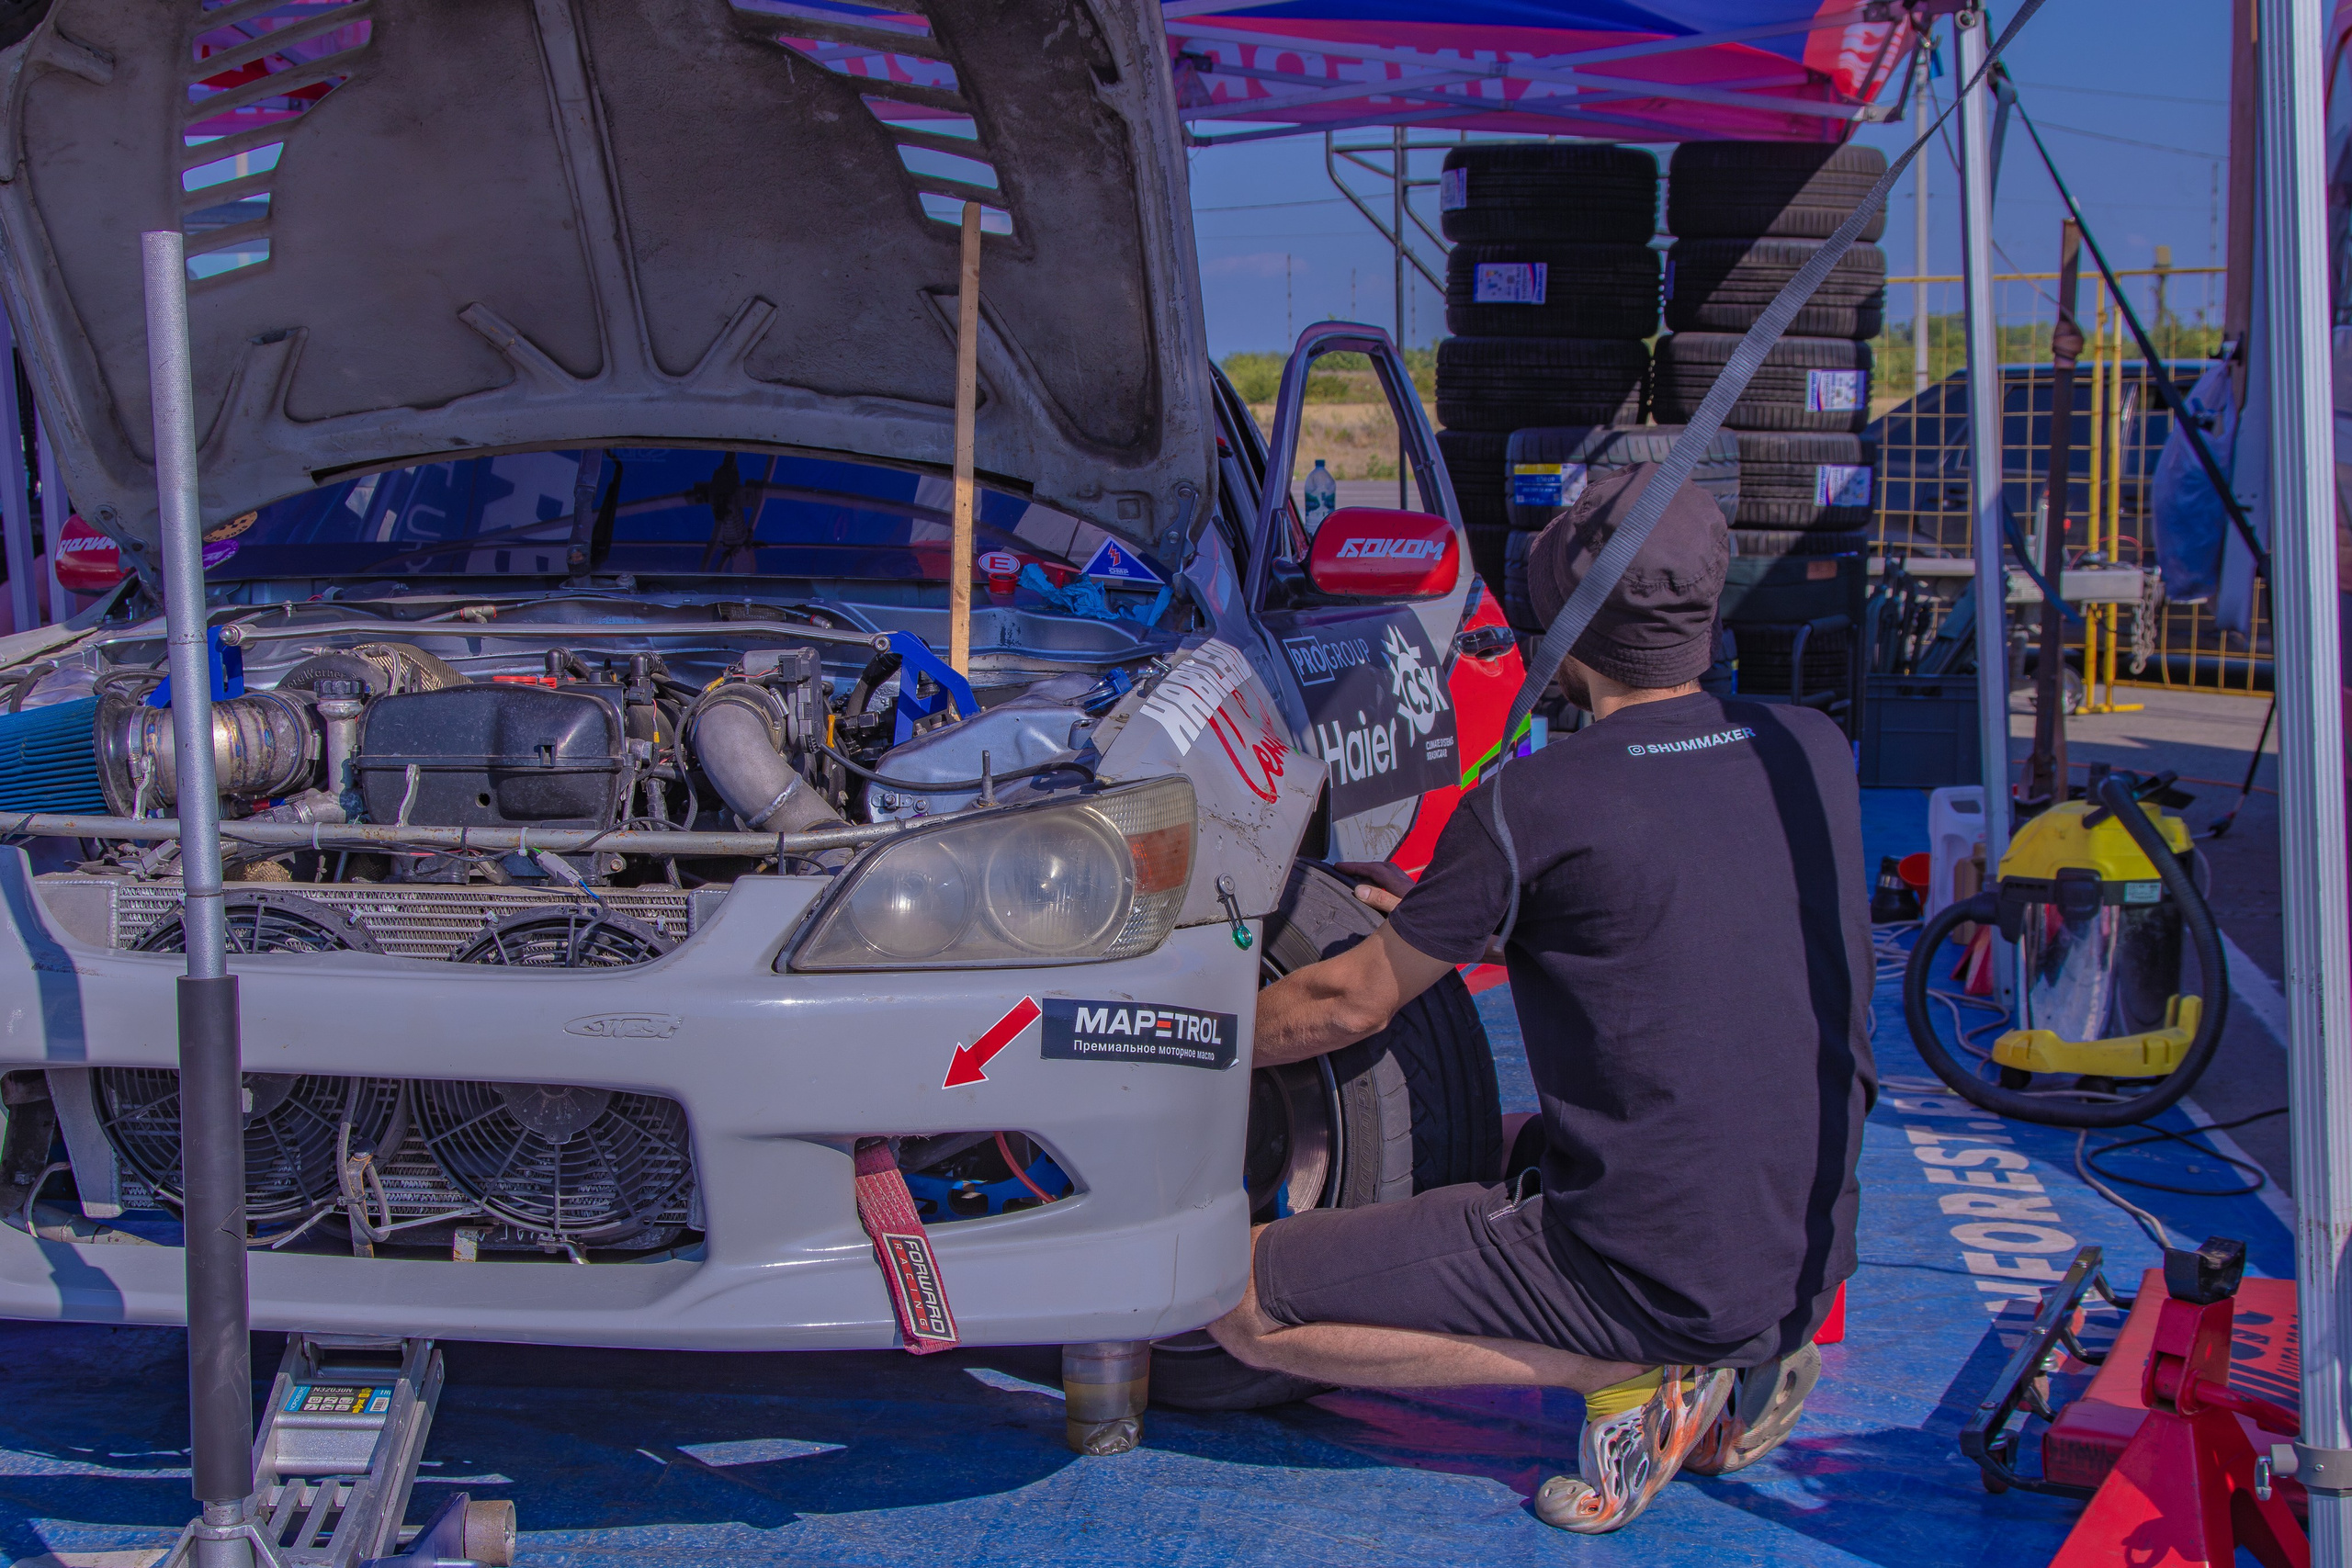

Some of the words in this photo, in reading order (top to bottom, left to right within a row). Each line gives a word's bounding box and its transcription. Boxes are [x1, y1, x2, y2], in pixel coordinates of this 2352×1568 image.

[1337, 538, 1446, 560] БОКОМ
[989, 556, 1010, 570] E
[282, 668, 347, 689] orgWarner
[1317, 709, 1397, 789] Haier
[1426, 739, 1441, 750] CLIMATE
[1646, 727, 1757, 754] SHUMMAXER
[1074, 1007, 1222, 1044] MAPETROL
[1073, 1040, 1156, 1054] Премиальное
[1159, 1045, 1196, 1058] моторное
[1196, 1049, 1216, 1061] масло
[894, 1243, 928, 1326] RACING
[904, 1240, 945, 1334] FORWARD
